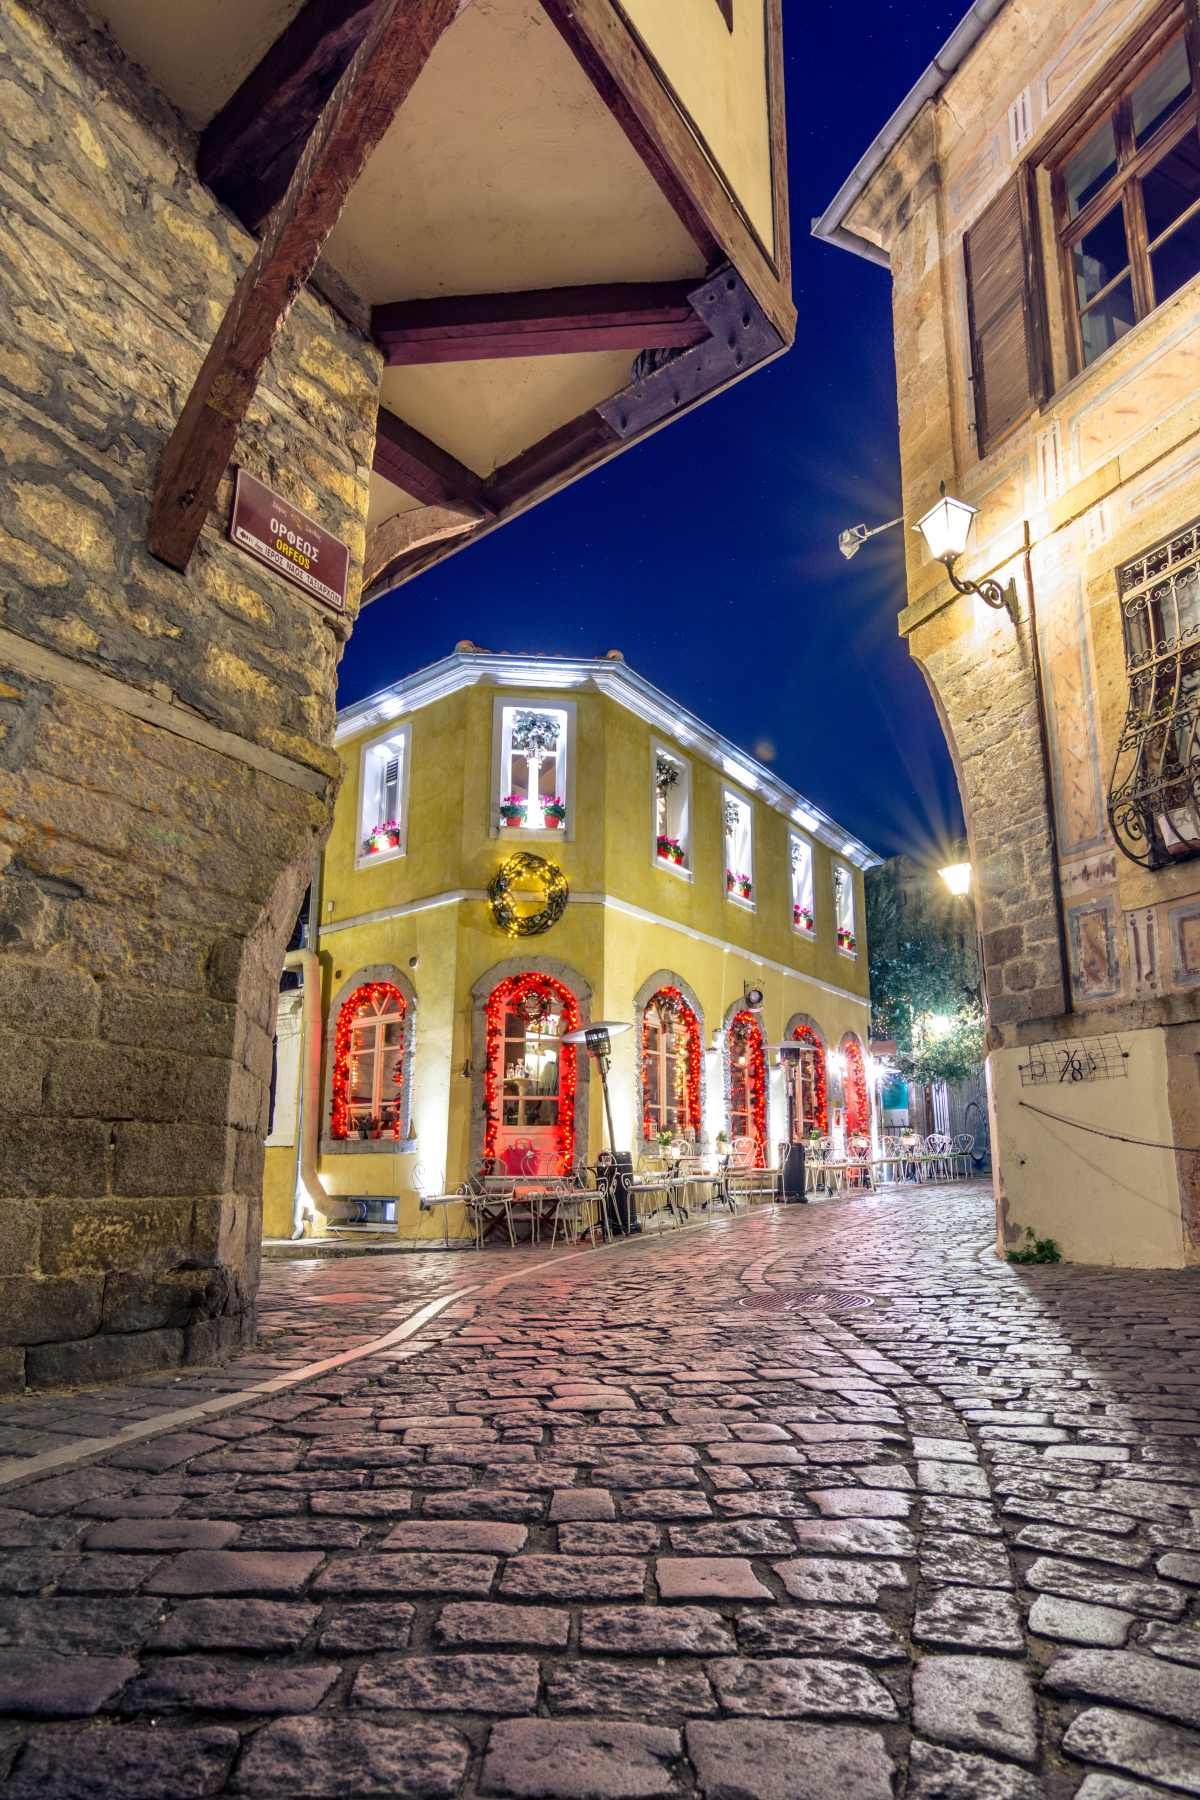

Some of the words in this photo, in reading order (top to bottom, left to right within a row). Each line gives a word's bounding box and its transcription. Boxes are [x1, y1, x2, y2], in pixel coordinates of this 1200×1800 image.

[270, 518, 319, 563] ΟΡΦΕΩΣ
[276, 539, 311, 570] ORFEOS
[265, 547, 284, 565] ΙΕΡΟΣ
[286, 561, 304, 579] ΝΑΟΣ
[307, 575, 340, 603] ΤΑΞΙΑΡΧΩΝ
